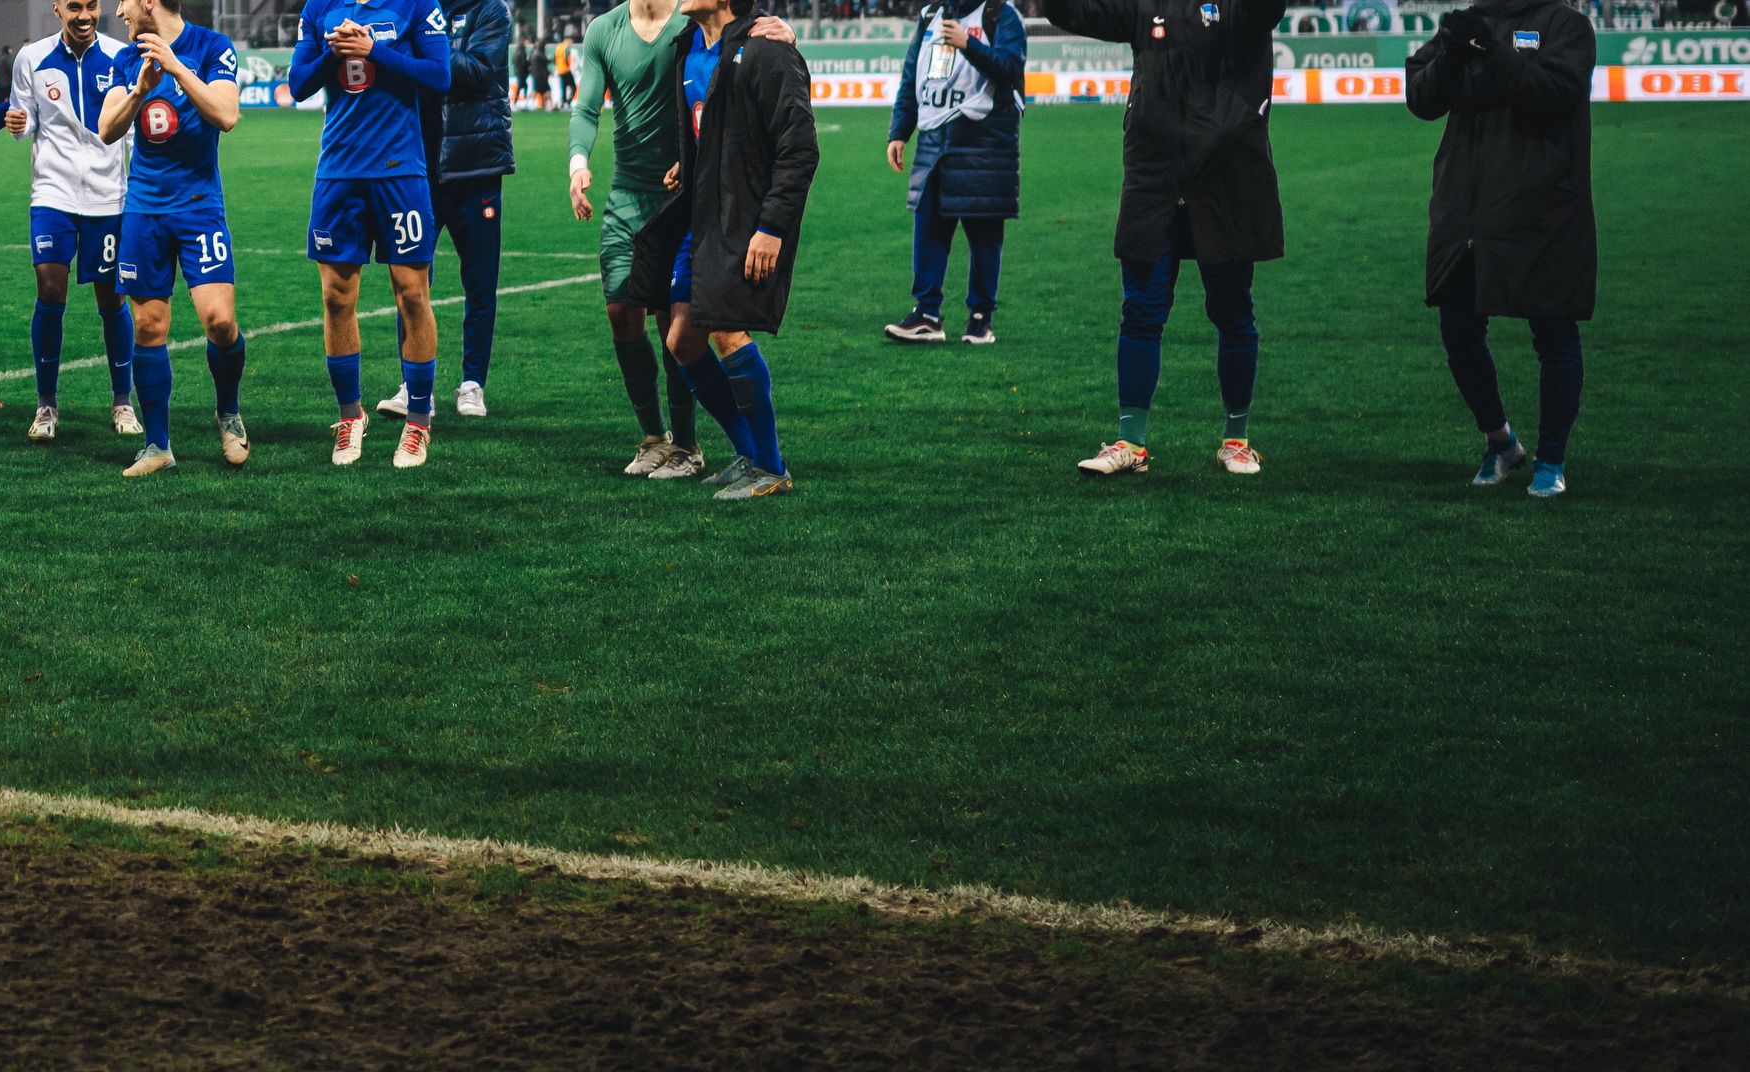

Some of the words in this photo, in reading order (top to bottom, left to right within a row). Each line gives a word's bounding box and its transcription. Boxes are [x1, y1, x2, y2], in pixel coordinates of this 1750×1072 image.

[1662, 38, 1750, 64] LOTTO
[346, 60, 367, 86] B
[869, 56, 901, 73] FÜR
[810, 81, 886, 99] OBI
[1070, 79, 1131, 97] OB
[1335, 75, 1402, 96] OB
[1641, 71, 1743, 95] OBI
[147, 107, 169, 135] B
[391, 210, 423, 245] 30
[103, 233, 116, 263] 8
[196, 231, 228, 263] 16
